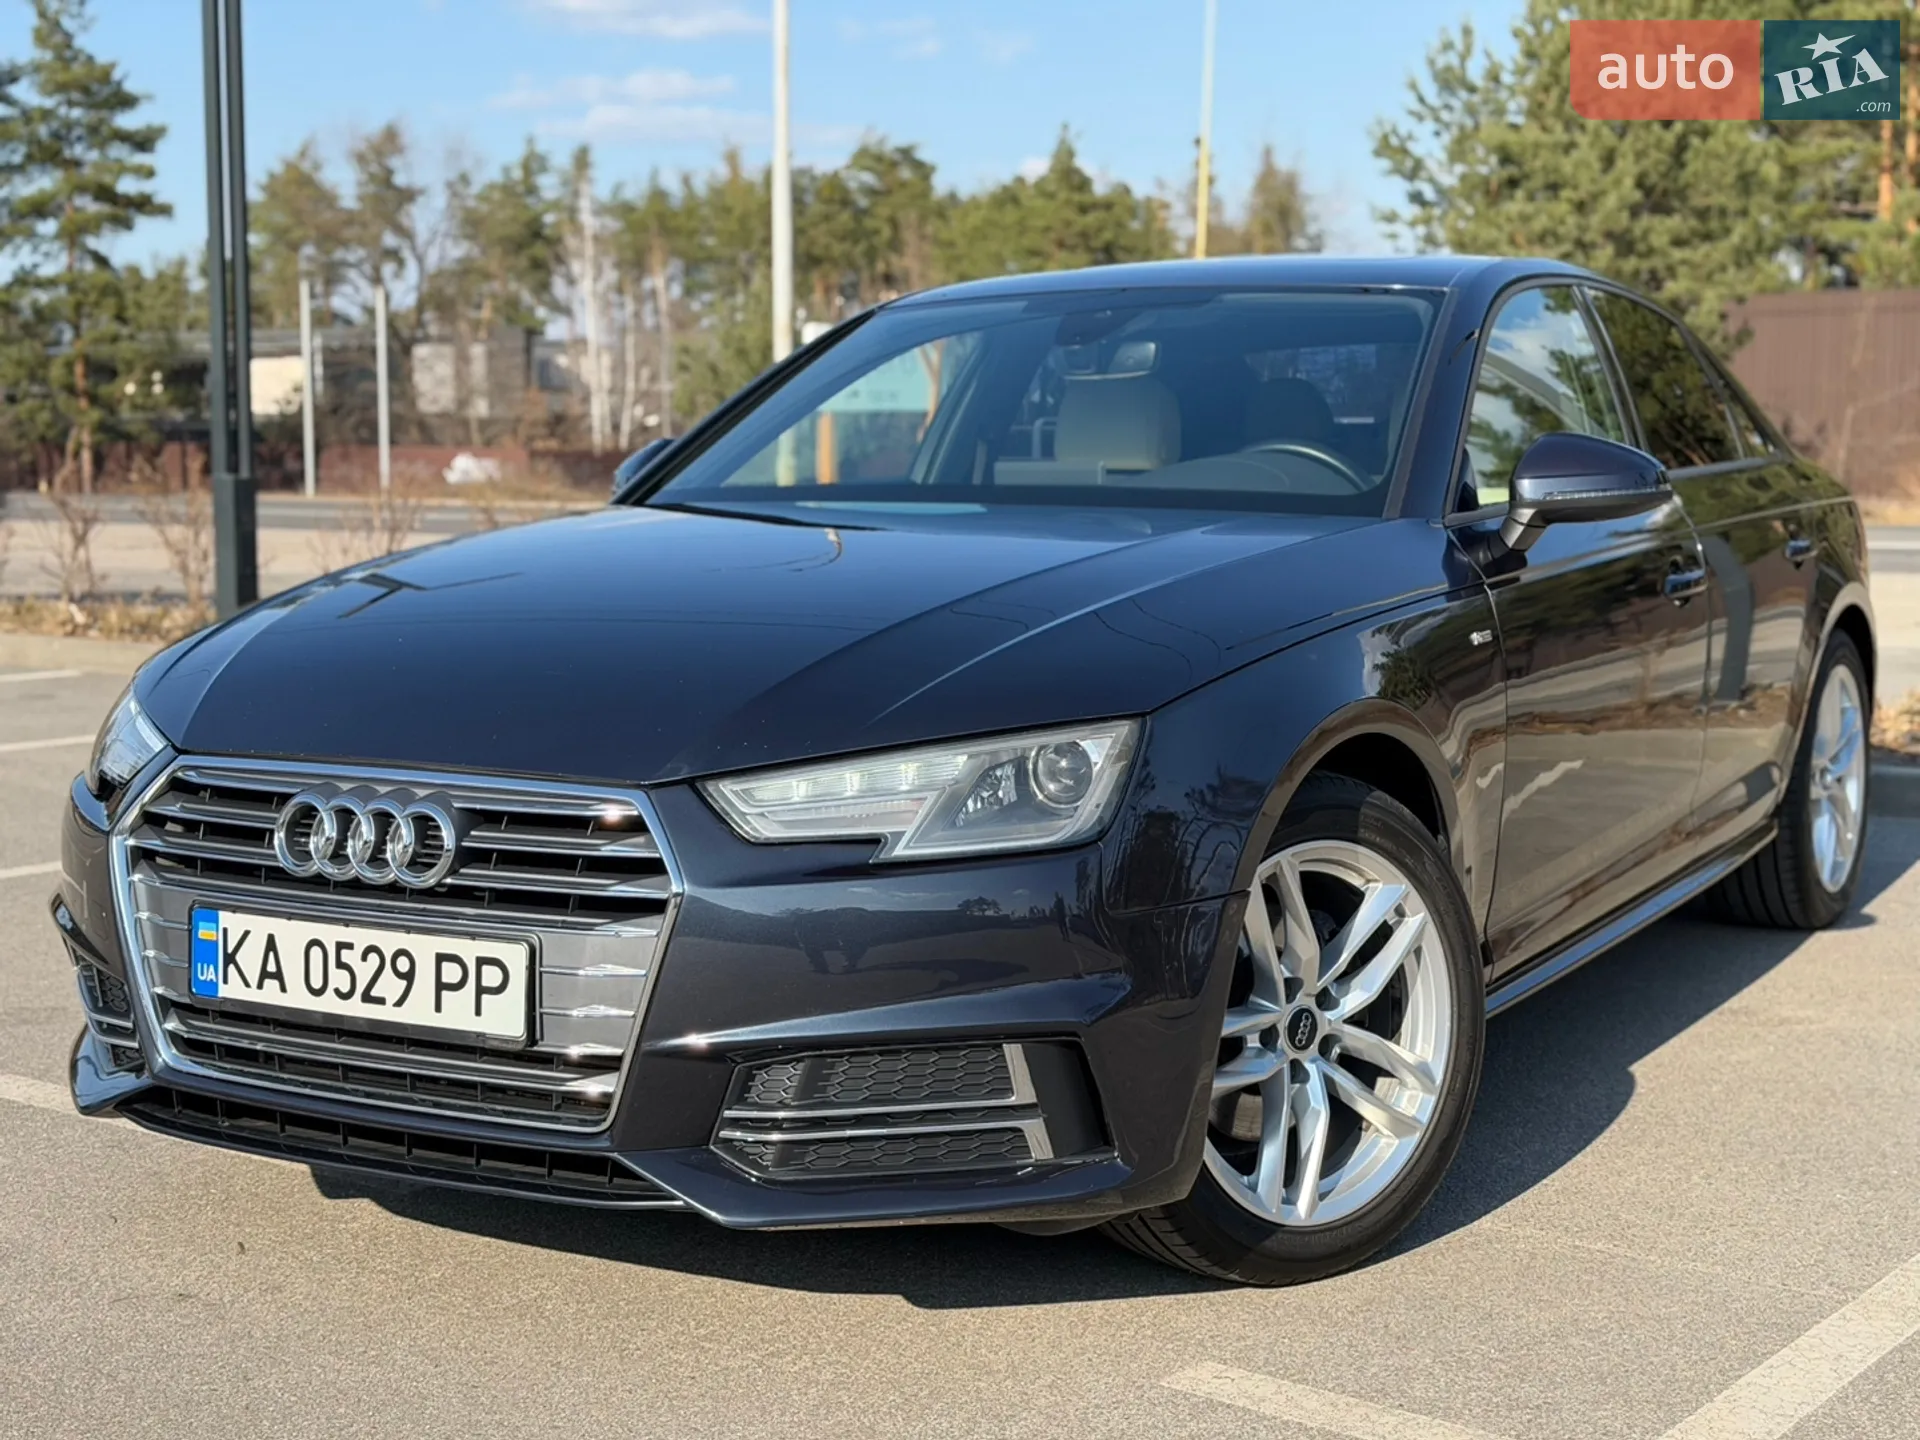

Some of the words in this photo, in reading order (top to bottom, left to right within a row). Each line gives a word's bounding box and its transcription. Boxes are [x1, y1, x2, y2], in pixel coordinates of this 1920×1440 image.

[197, 963, 217, 983] UA
[222, 926, 288, 994] KA
[303, 938, 416, 1008] 0529
[433, 951, 510, 1018] PP
